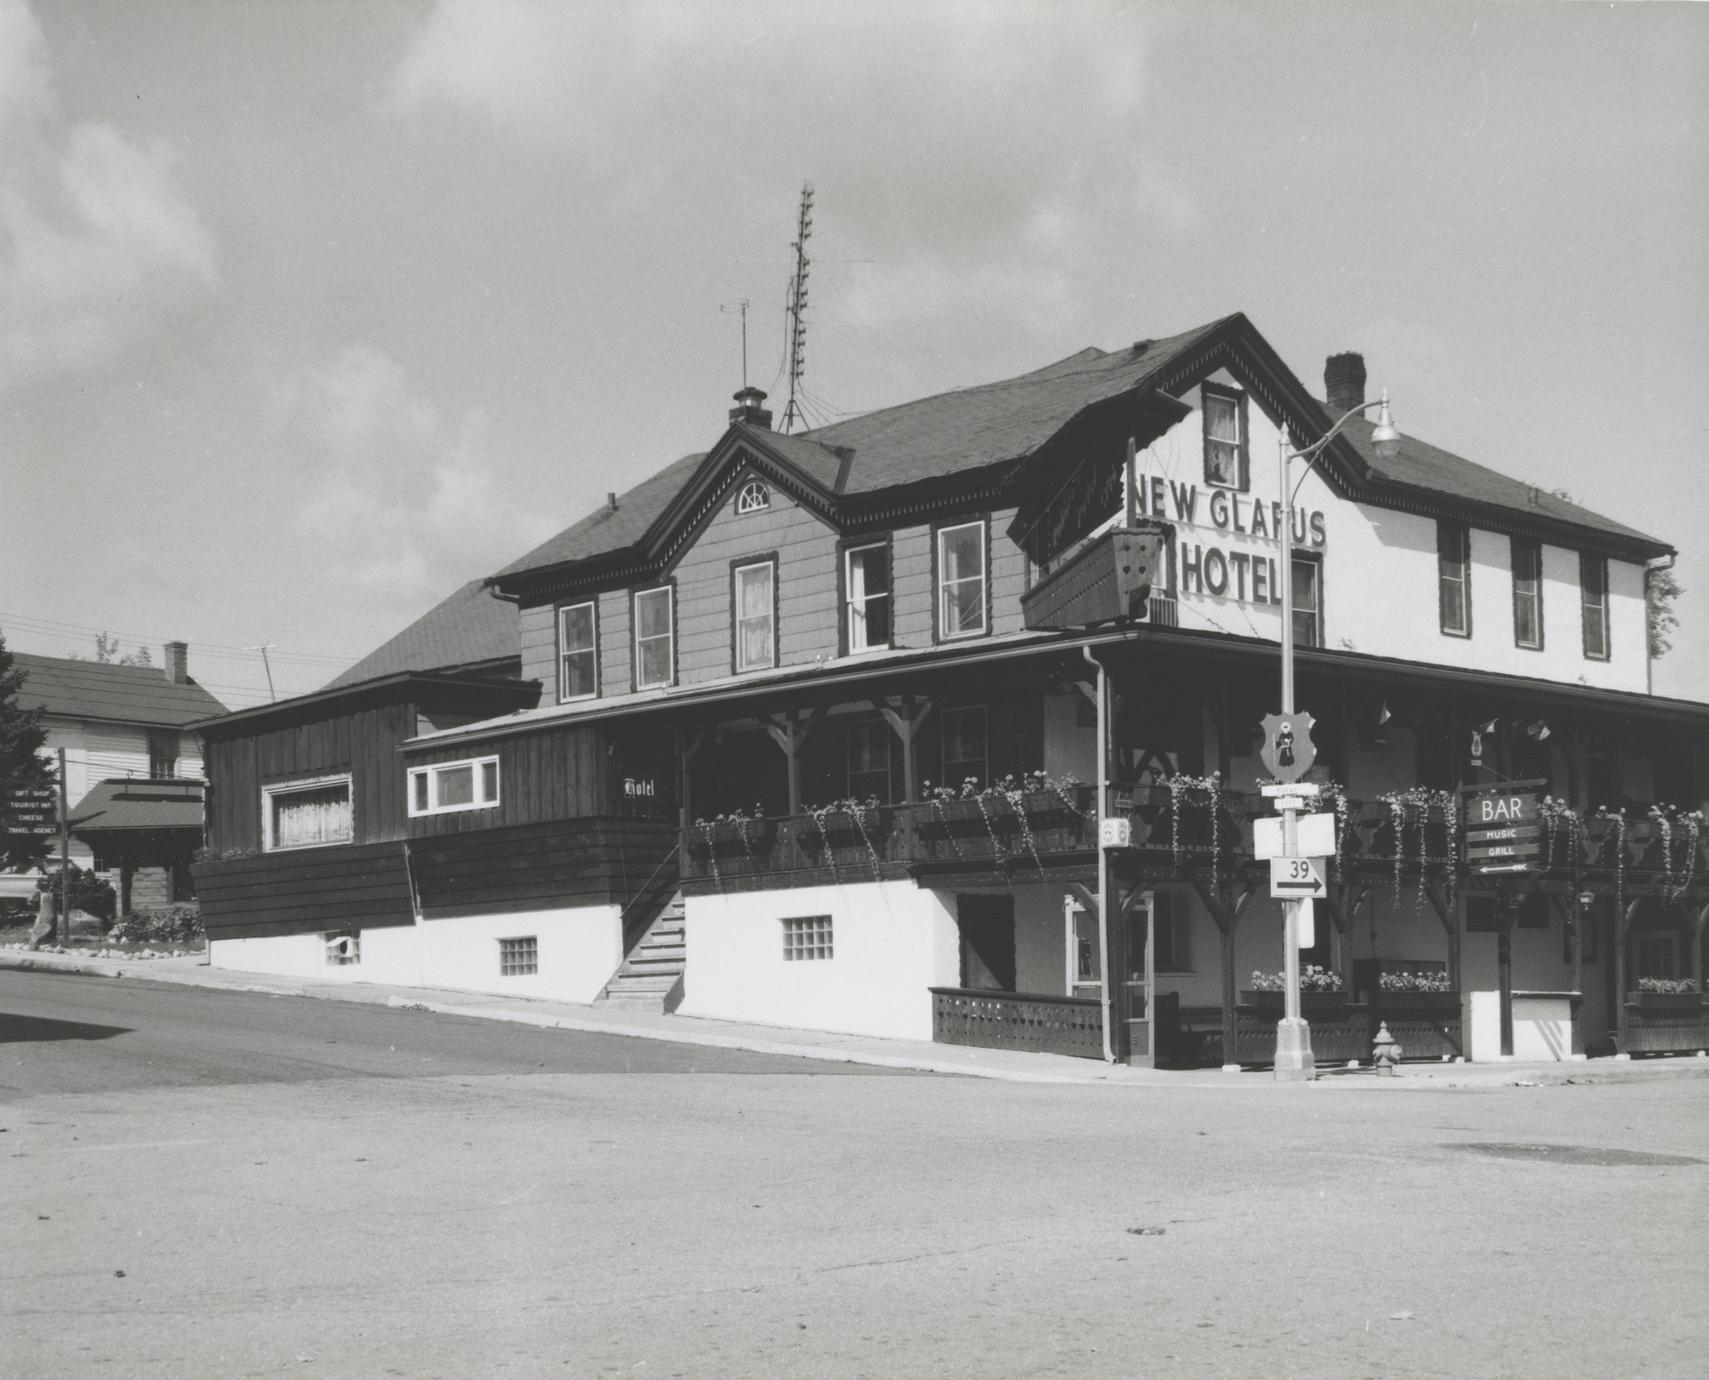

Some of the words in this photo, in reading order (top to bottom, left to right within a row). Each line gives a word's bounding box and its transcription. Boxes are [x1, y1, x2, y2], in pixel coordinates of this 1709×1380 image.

[1134, 474, 1196, 522] NEW
[1181, 541, 1282, 606] HOTEL
[624, 776, 655, 800] Hotel
[1482, 797, 1522, 821] BAR
[1486, 829, 1517, 839] MUSIC
[1488, 847, 1515, 856] GRILL
[1290, 860, 1309, 879] 39
